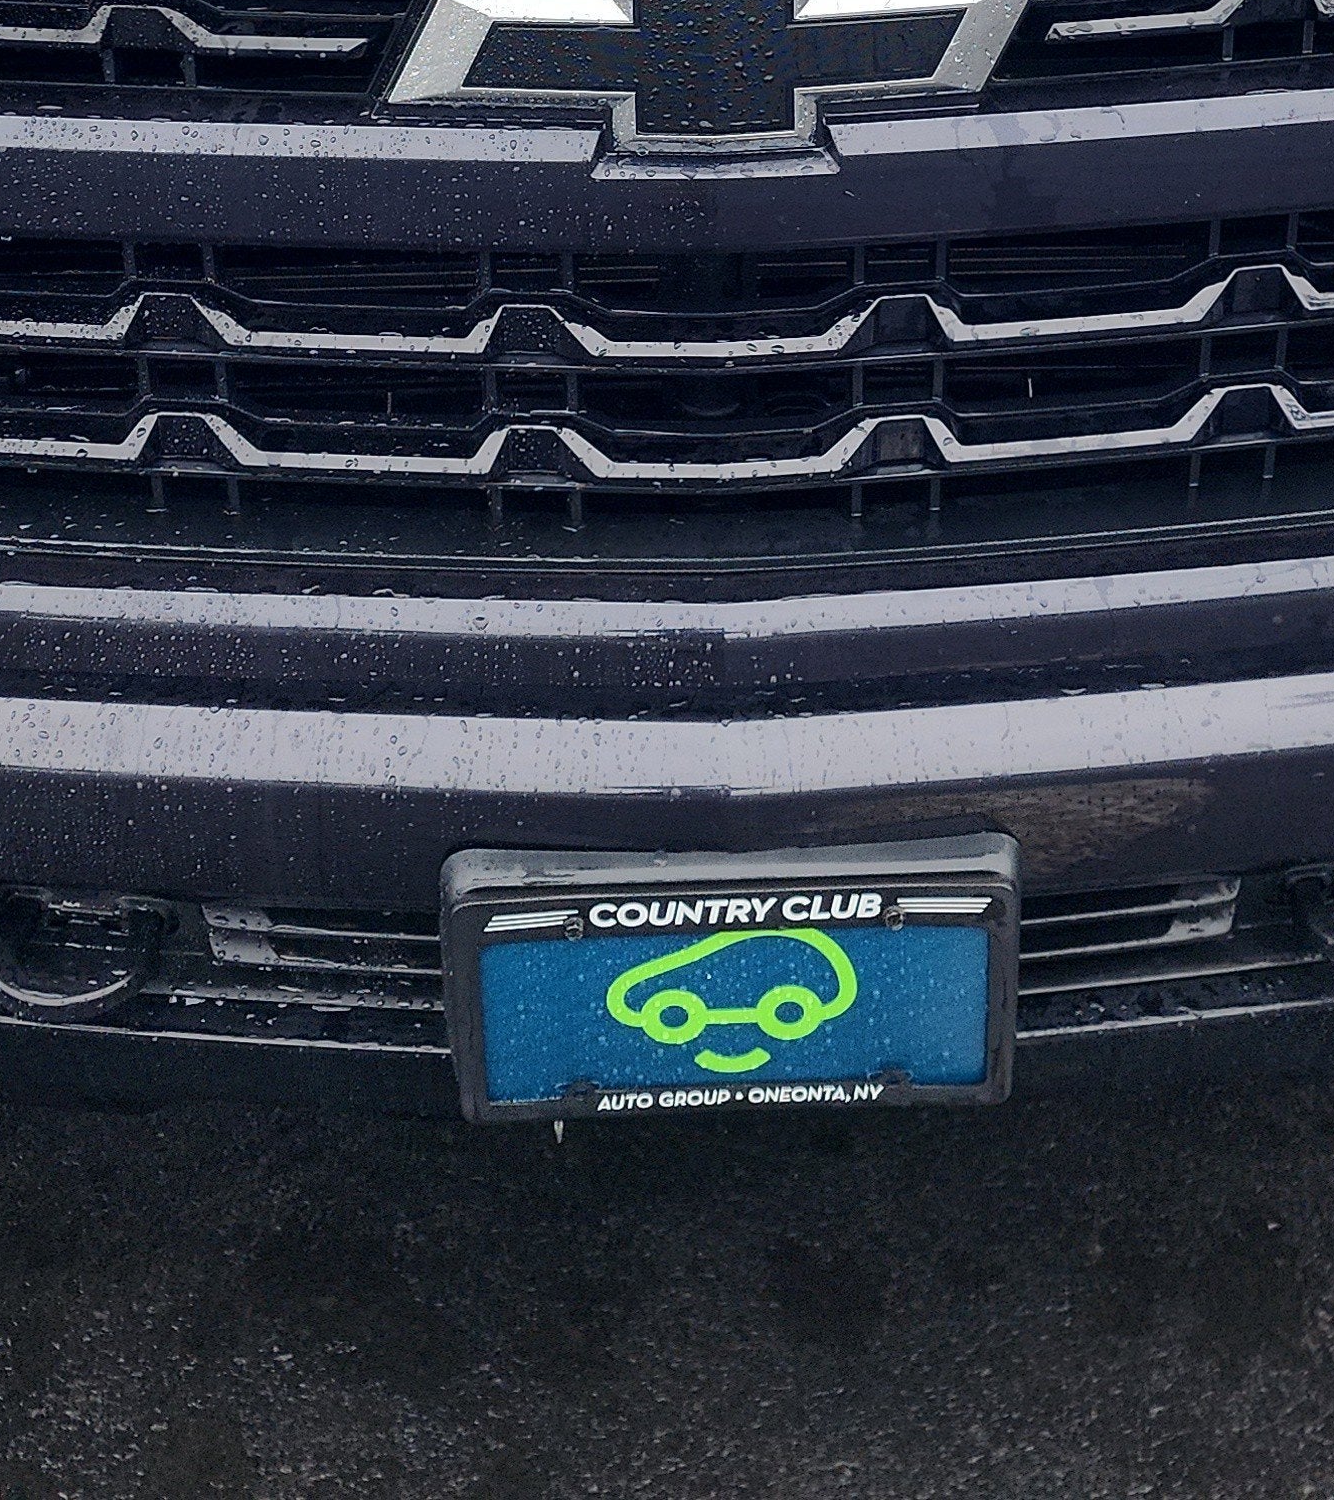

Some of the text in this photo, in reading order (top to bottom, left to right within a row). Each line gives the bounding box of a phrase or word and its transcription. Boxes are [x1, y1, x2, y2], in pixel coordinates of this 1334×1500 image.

[588, 893, 882, 929] COUNTRY CLUB
[597, 1092, 654, 1111] AUTO
[658, 1088, 731, 1108] GROUP
